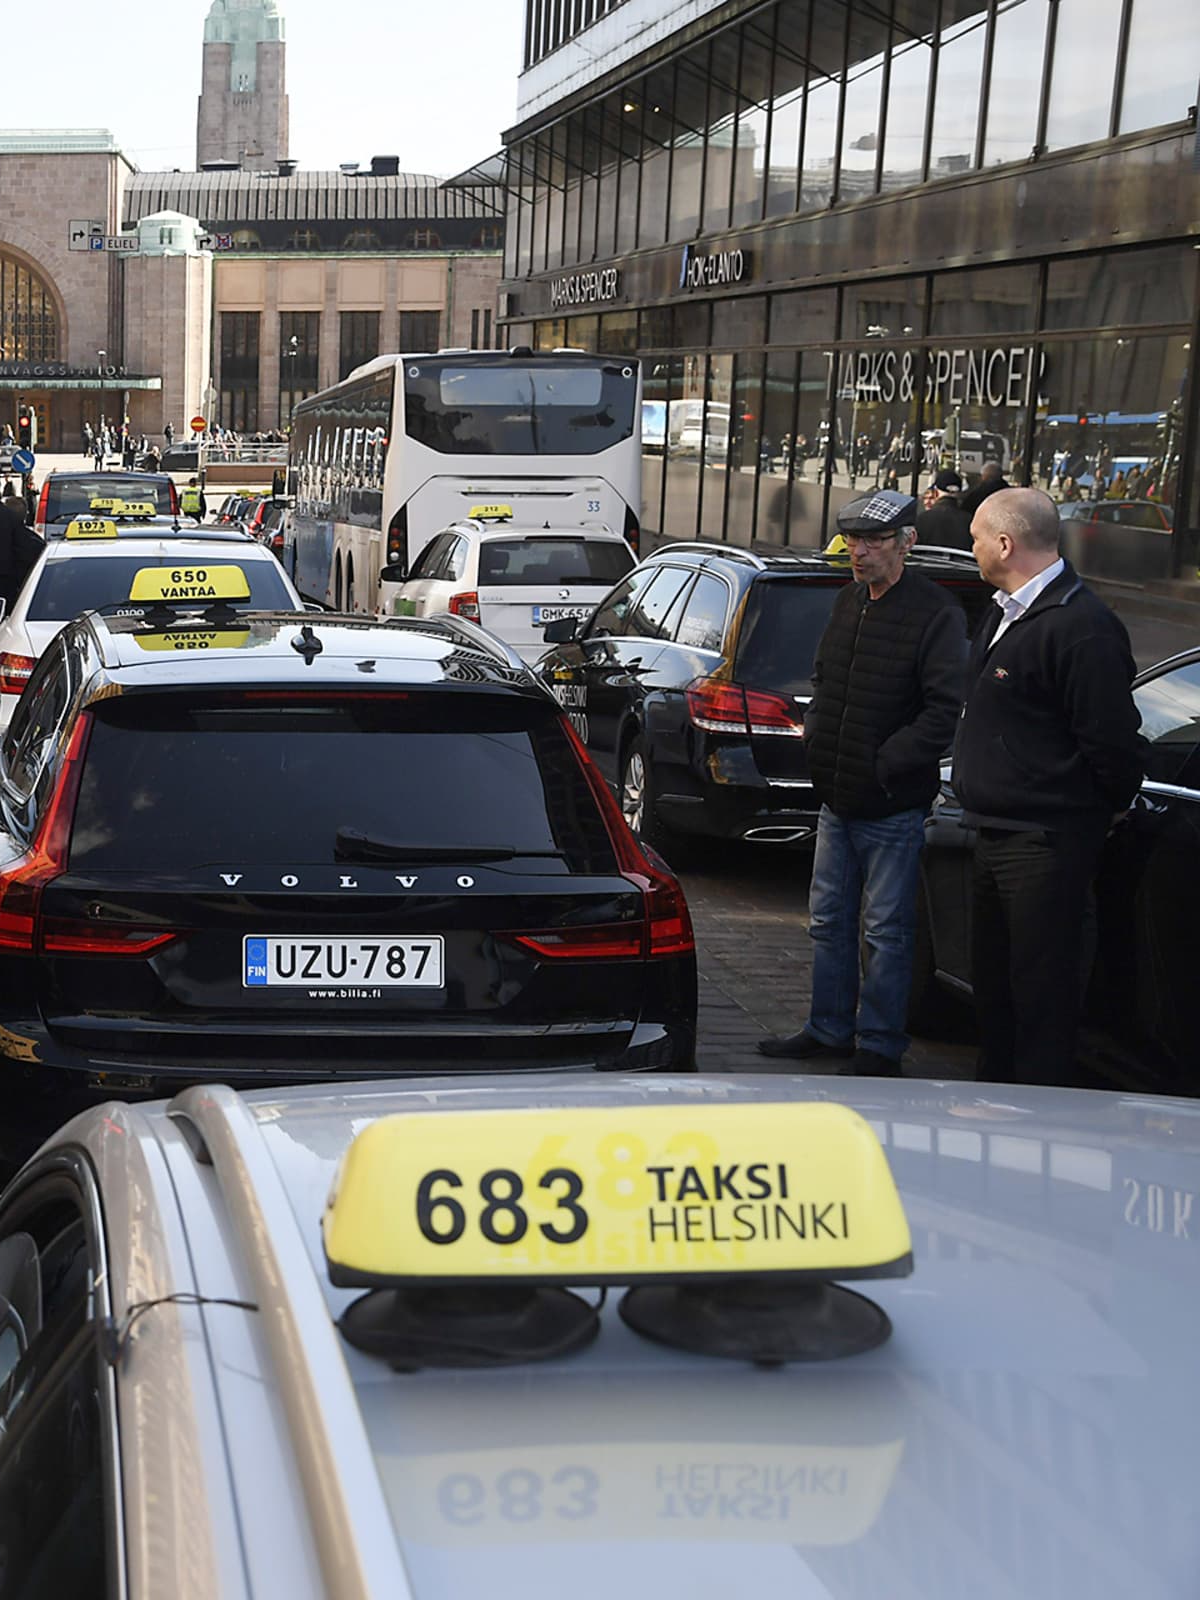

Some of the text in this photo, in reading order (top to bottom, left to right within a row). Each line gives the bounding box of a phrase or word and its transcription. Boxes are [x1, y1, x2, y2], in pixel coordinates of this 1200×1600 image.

[108, 239, 134, 249] ELIEL
[551, 277, 575, 307] MARKS
[580, 268, 618, 303] SPENCER
[900, 350, 914, 403] &
[587, 500, 600, 512] 33
[171, 570, 207, 583] 650
[160, 586, 216, 598] VANTAA
[541, 608, 592, 620] GMK-654
[220, 873, 475, 888] VOLVO
[247, 944, 433, 980] FIN UZU-787
[308, 988, 381, 999] www.bilia.fi
[646, 1163, 789, 1202] TAKSI
[416, 1168, 589, 1245] 683
[648, 1202, 850, 1243] HELSINKI
